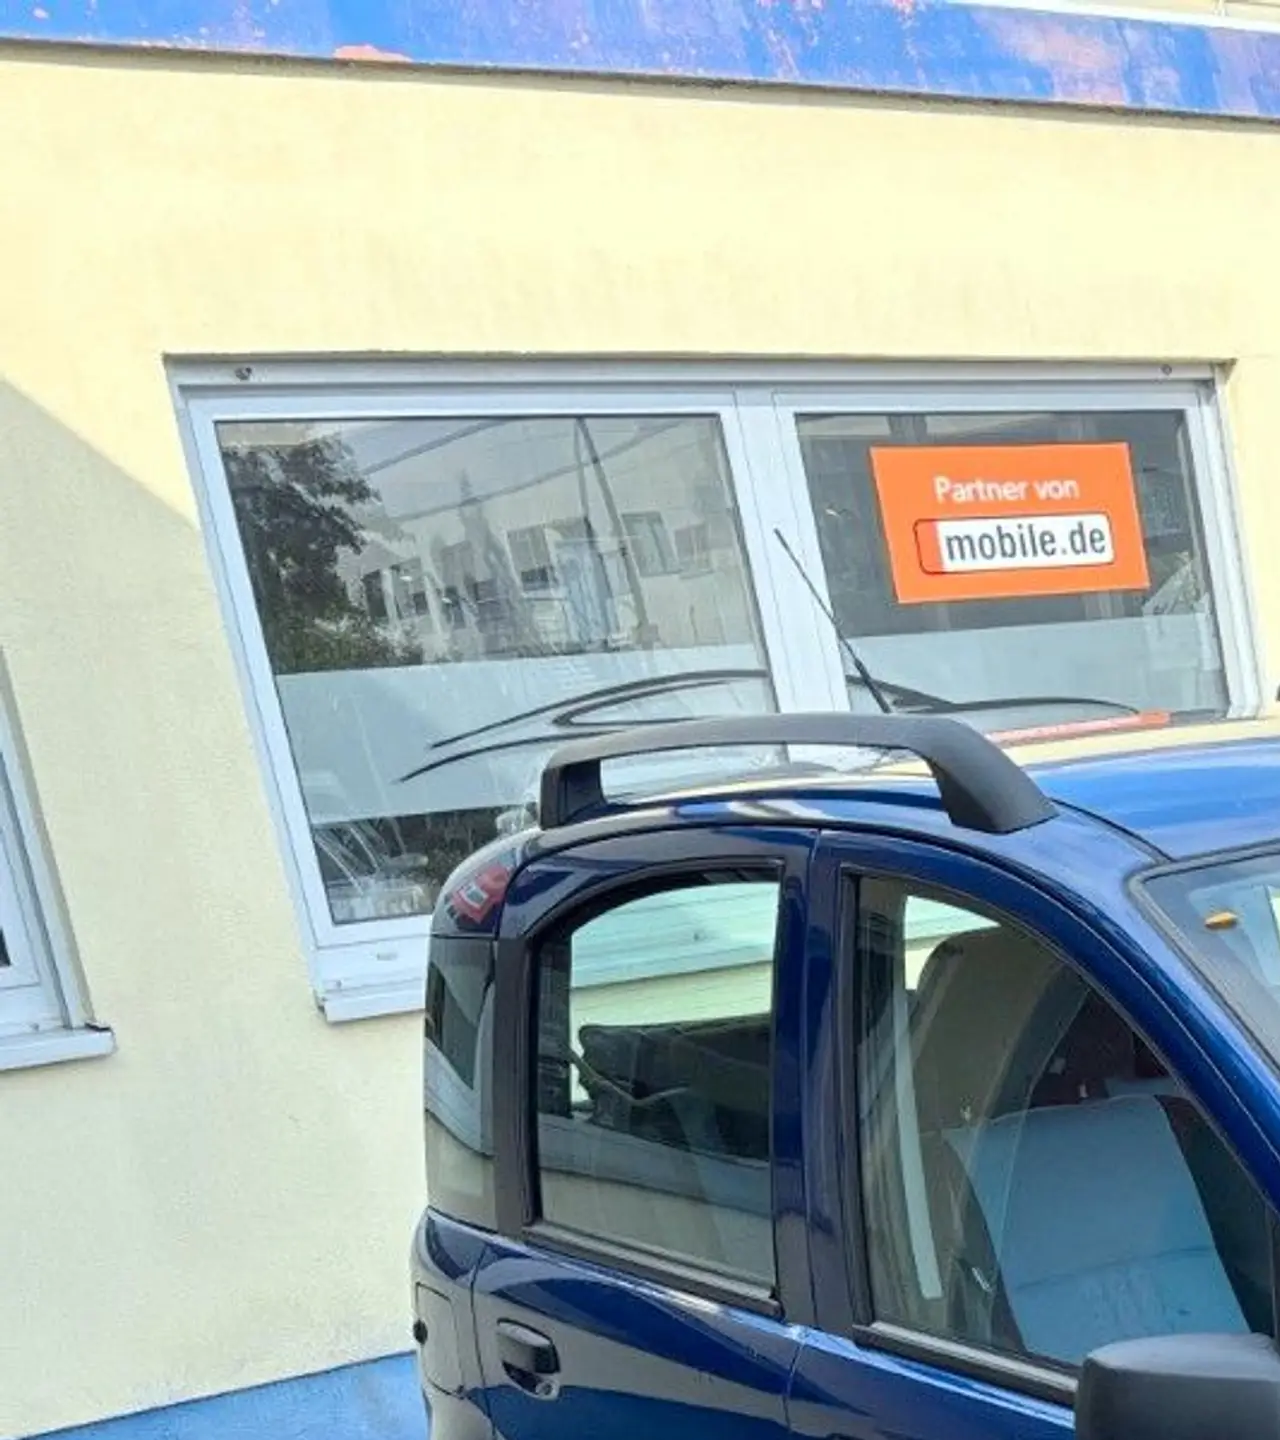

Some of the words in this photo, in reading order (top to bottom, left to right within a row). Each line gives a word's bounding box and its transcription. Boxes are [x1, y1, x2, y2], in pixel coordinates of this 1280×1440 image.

[934, 476, 1028, 502] Partner
[1034, 478, 1080, 500] von
[945, 520, 1107, 561] mobile.de
